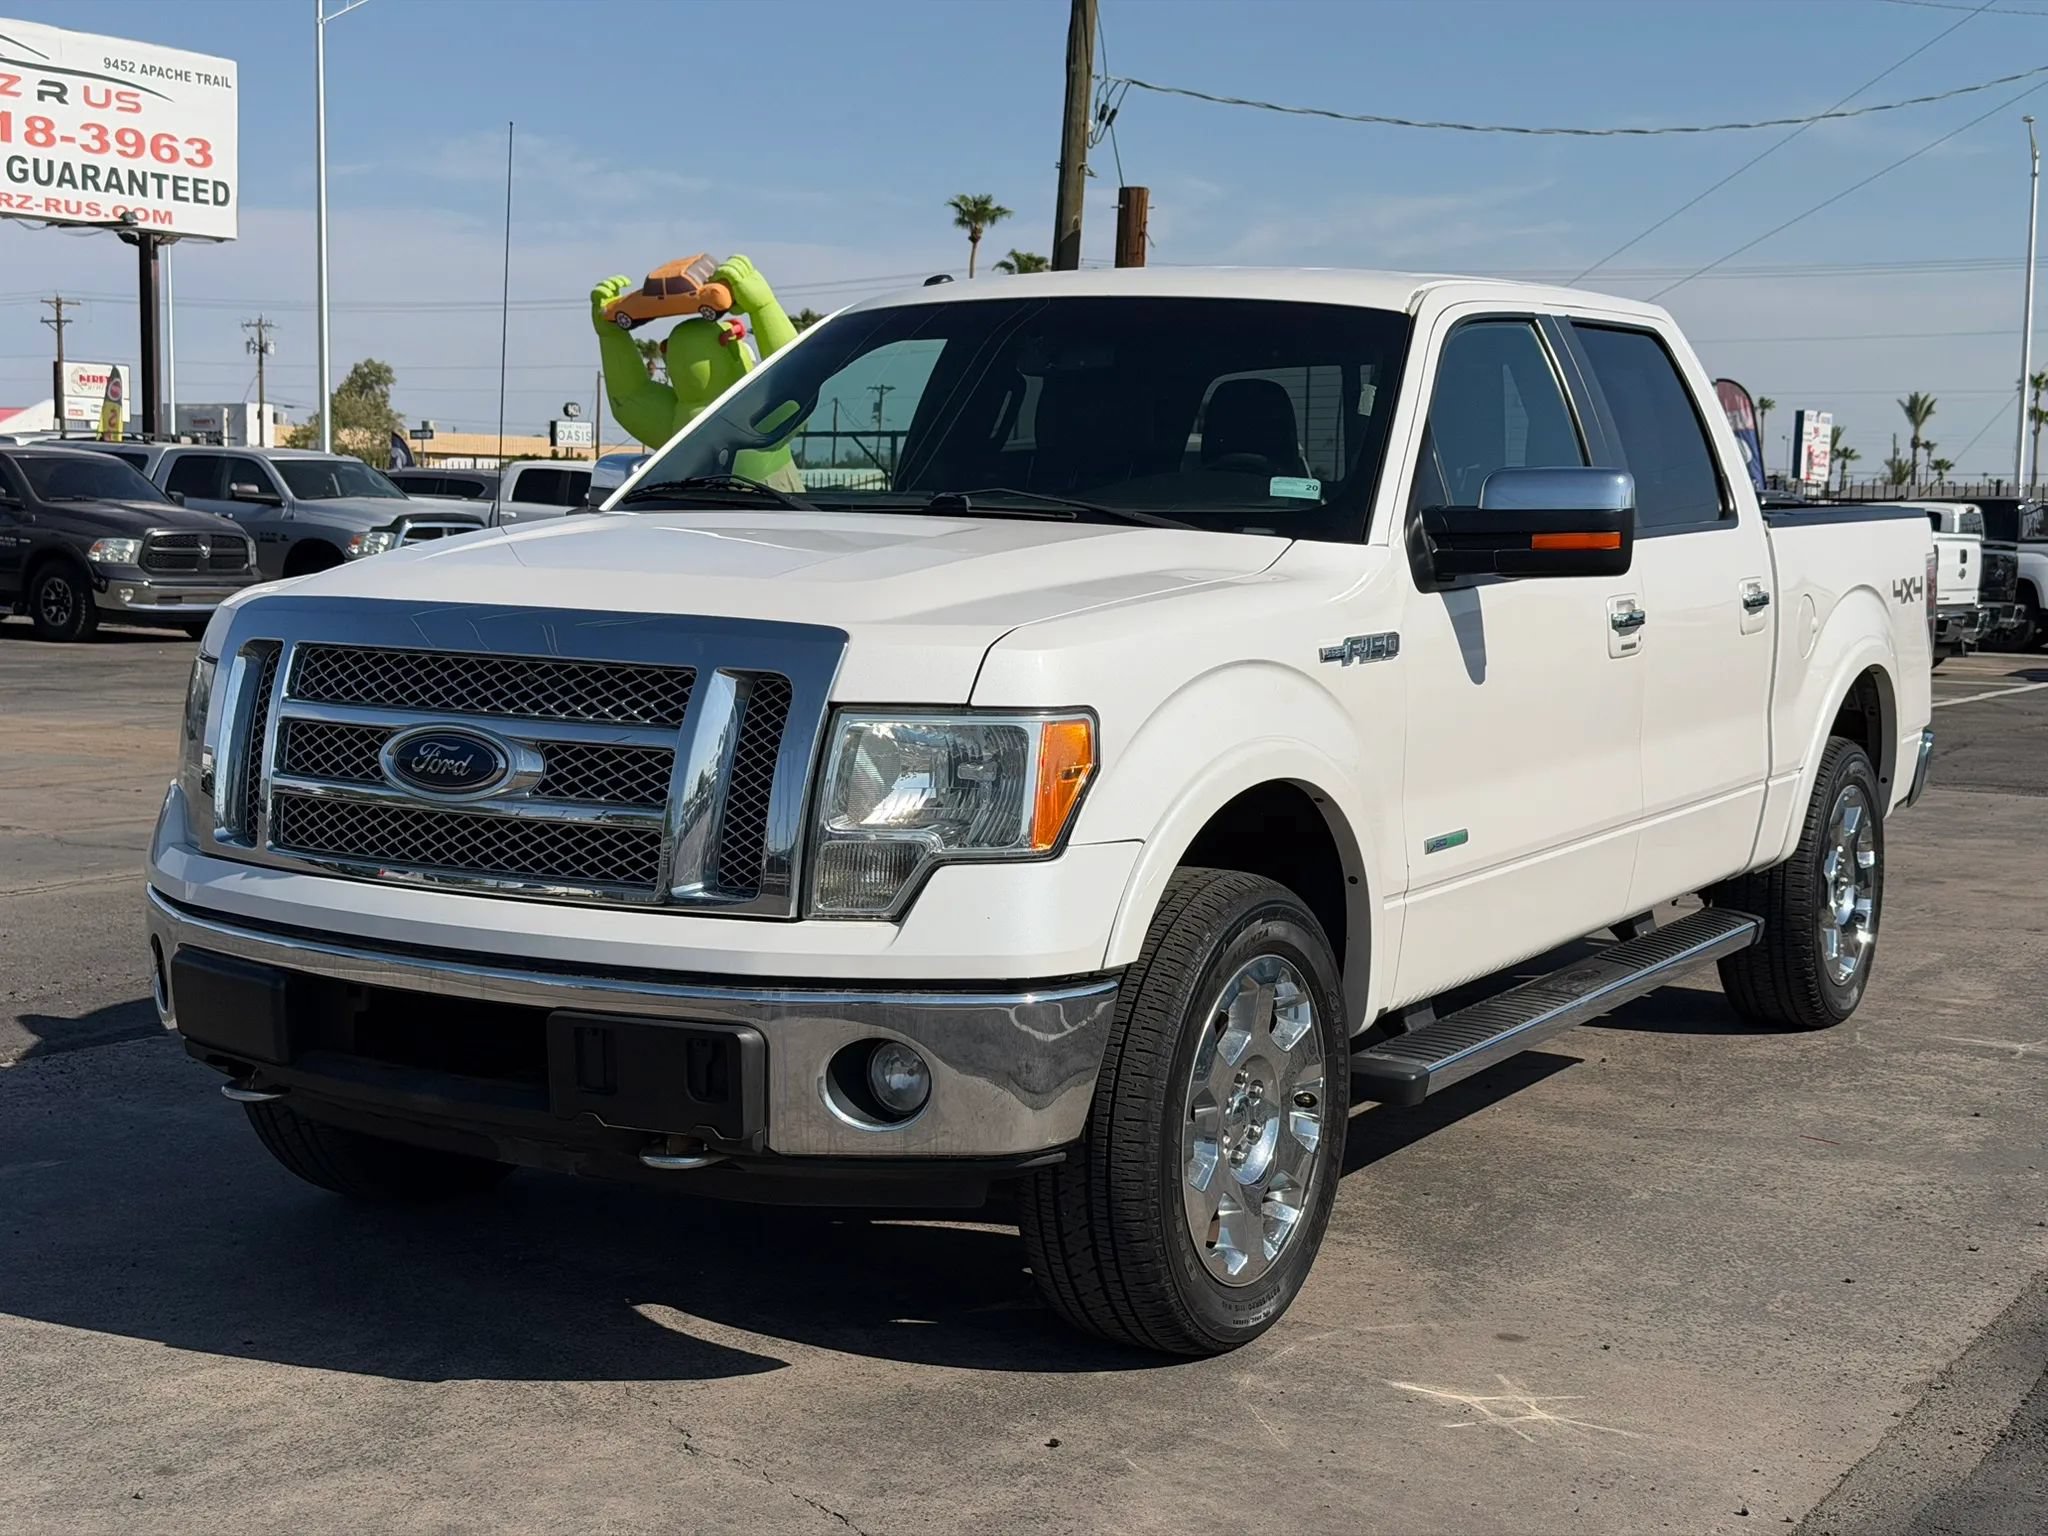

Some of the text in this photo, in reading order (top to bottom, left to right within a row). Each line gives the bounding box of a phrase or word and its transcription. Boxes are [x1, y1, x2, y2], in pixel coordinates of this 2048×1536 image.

[103, 57, 232, 89] 9452 APACHE TRAIL
[37, 79, 70, 106] R
[83, 85, 142, 114] US
[0, 110, 214, 168] 18-3963
[6, 155, 231, 207] GUARANTEED
[558, 430, 592, 442] OASIS
[1305, 484, 1319, 492] 20
[411, 741, 475, 777] Ford
